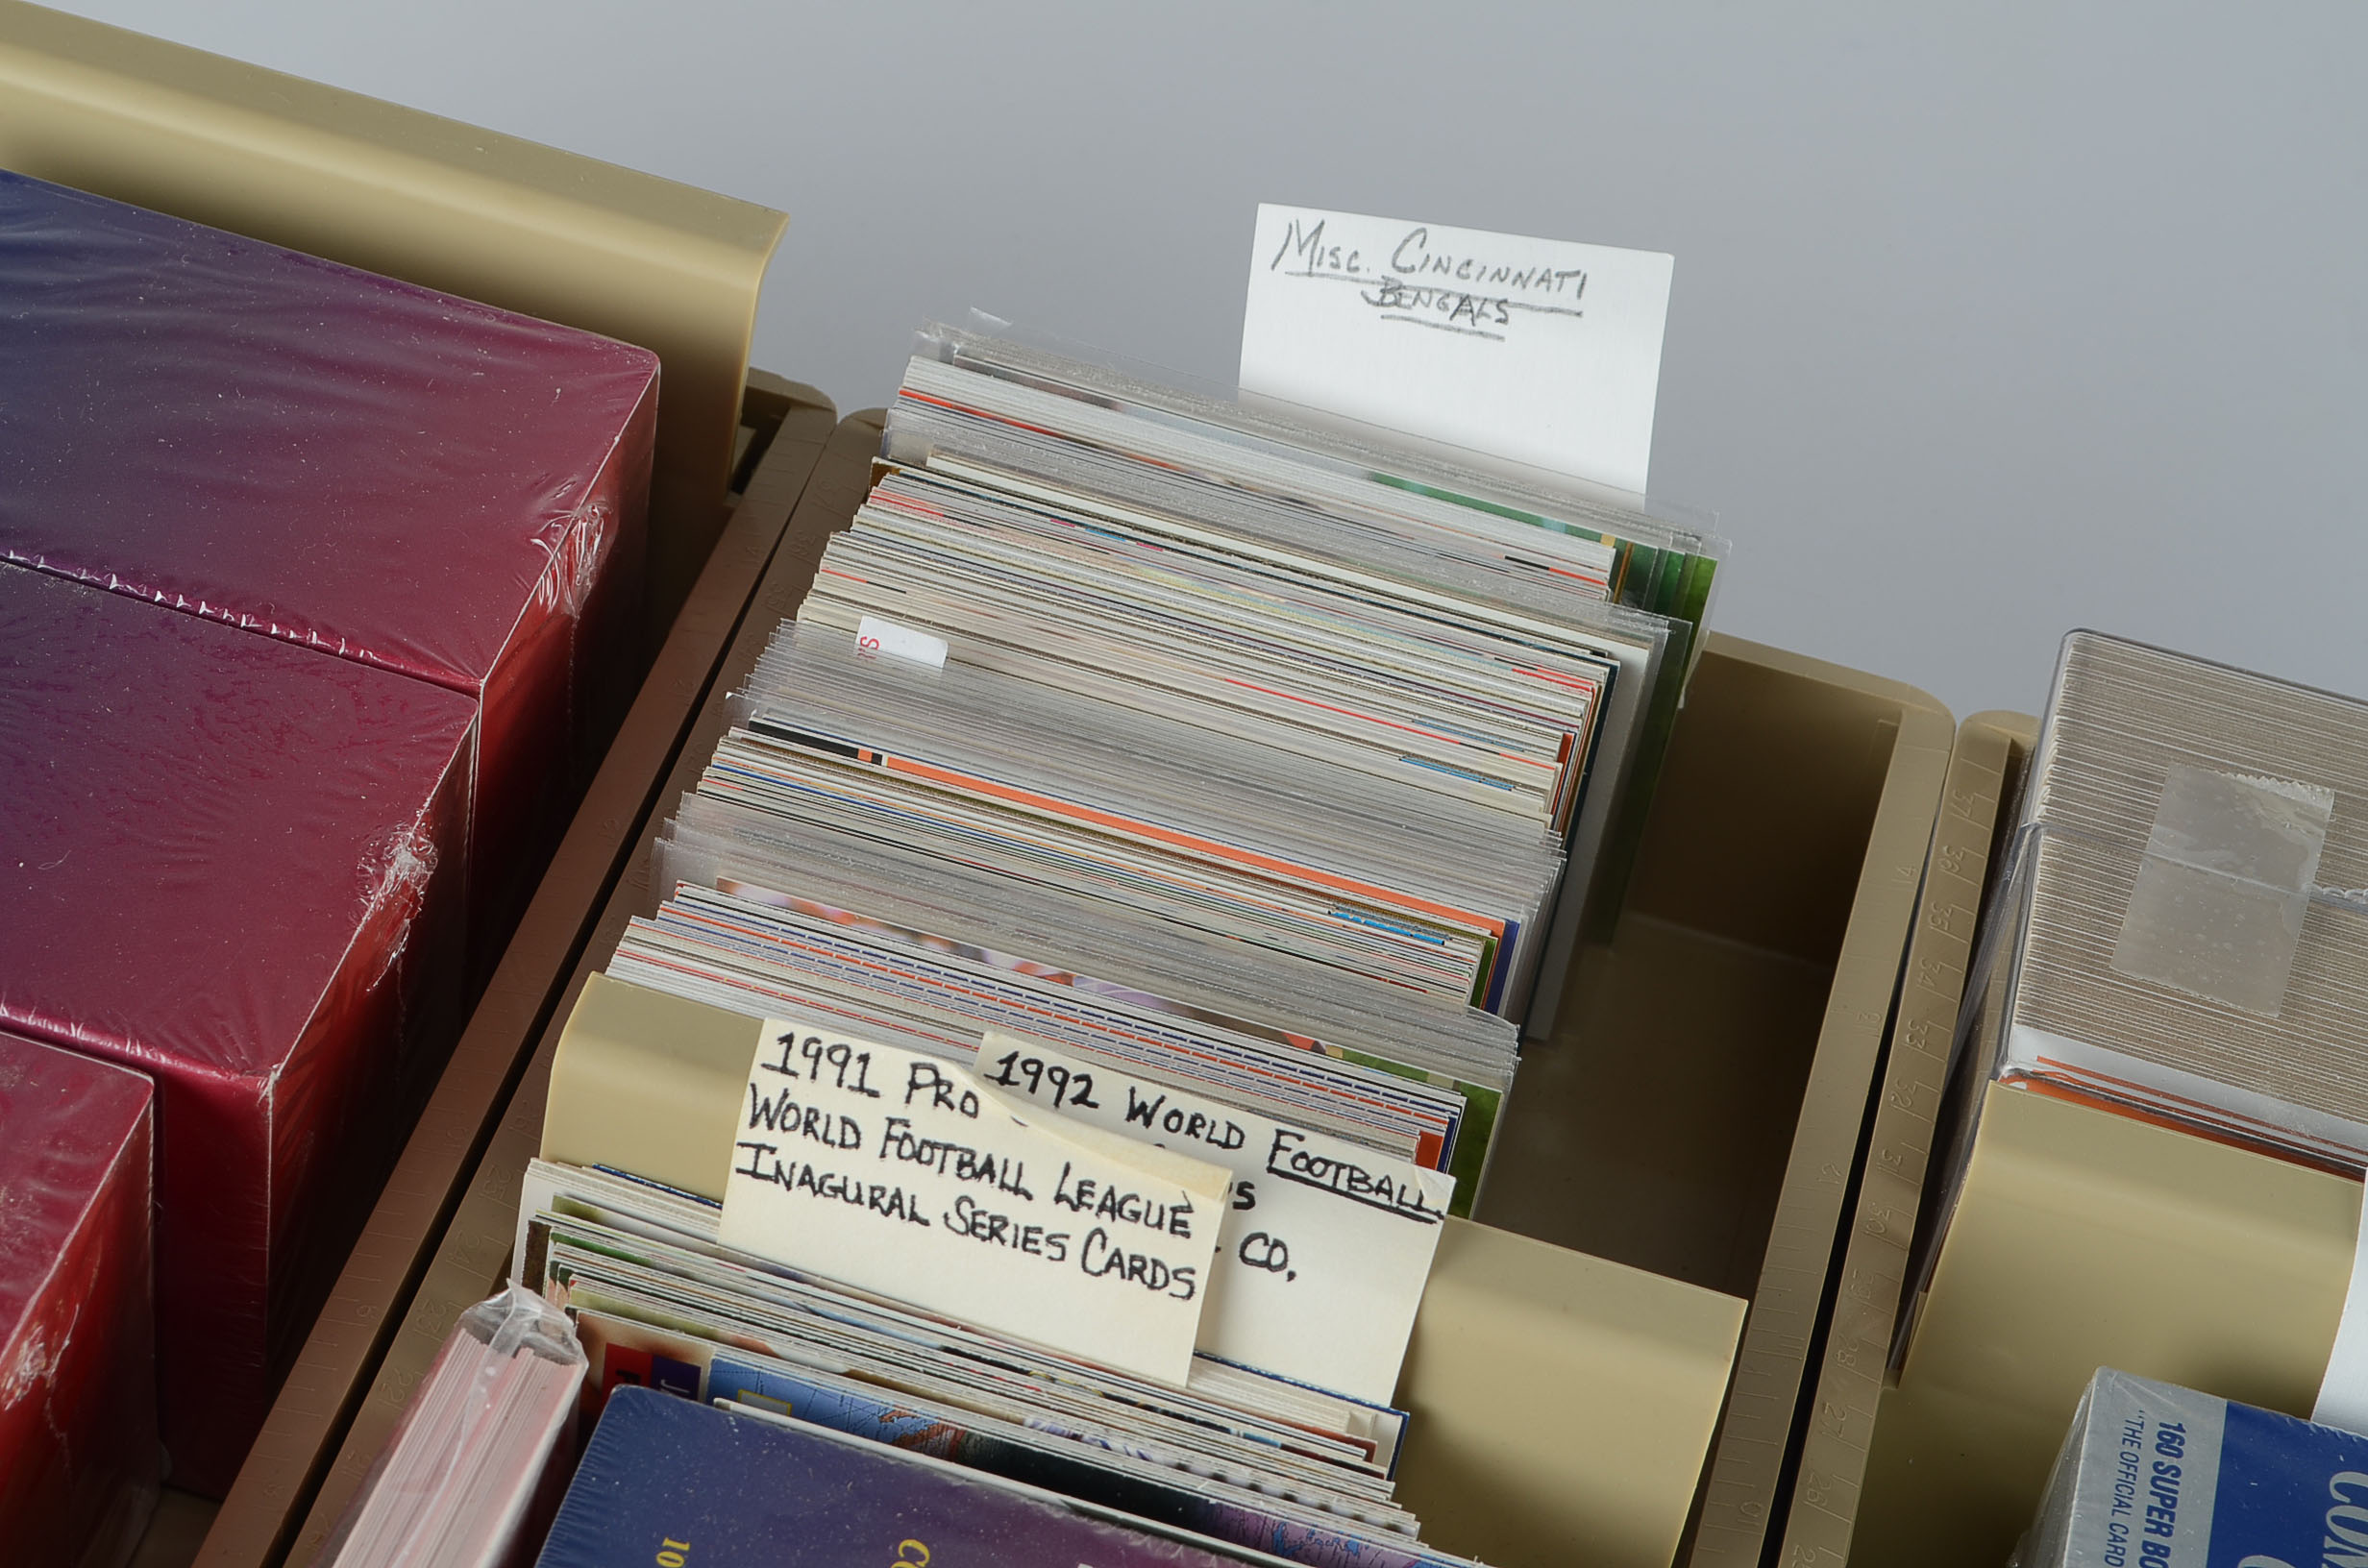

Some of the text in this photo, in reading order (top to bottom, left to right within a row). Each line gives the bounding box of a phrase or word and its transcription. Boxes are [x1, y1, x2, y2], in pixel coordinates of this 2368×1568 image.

[1271, 219, 1588, 300] MISC. CINCINNATI
[1361, 275, 1510, 327] BENGALS
[761, 1032, 979, 1119] 1991 PRO
[983, 1050, 1100, 1109] 1992
[1124, 1087, 1246, 1150] WORLD
[750, 1083, 1196, 1239] WORLD FOOTBALL LEAGUE
[735, 1141, 1197, 1301] INAGURAL SERIES CARDS
[2155, 1421, 2186, 1459] 160
[2111, 1451, 2140, 1517] OFFICIAL
[2144, 1460, 2183, 1538] SUPER
[2104, 1522, 2130, 1568] CARD
